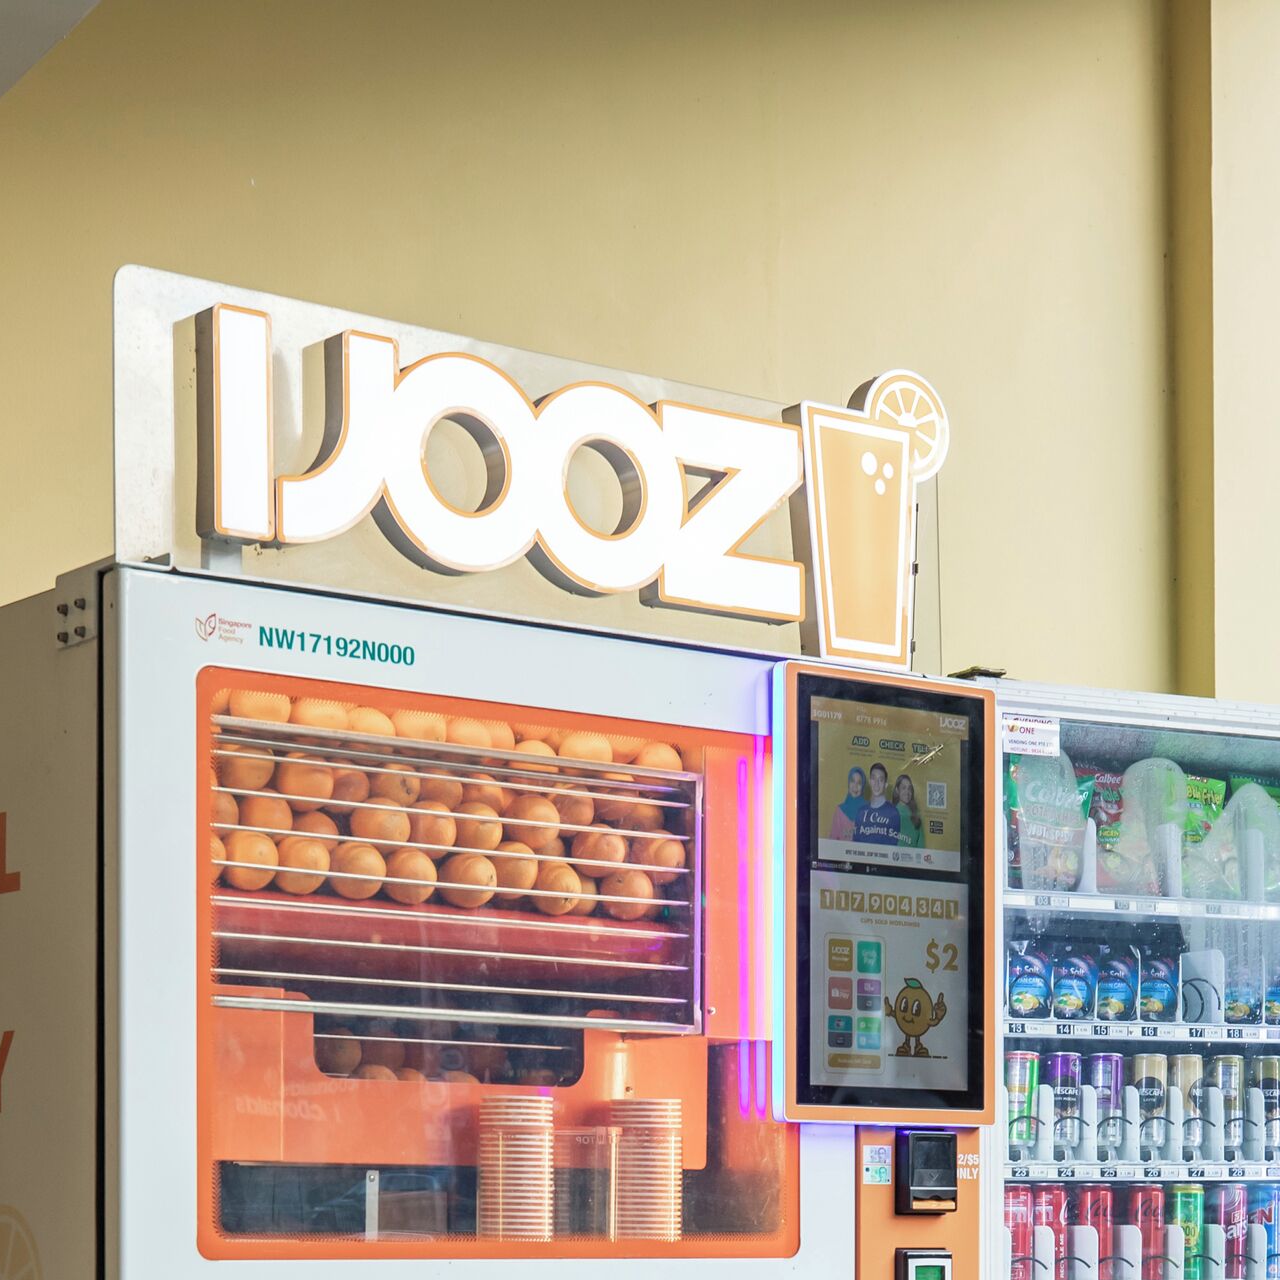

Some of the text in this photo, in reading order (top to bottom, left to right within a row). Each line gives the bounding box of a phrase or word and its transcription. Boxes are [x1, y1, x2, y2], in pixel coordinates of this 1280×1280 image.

[210, 303, 805, 623] IJOOZ
[259, 626, 415, 666] NW17192N000
[1019, 726, 1035, 735] ONE
[853, 737, 869, 746] ADD
[880, 740, 905, 750] CHECK
[1094, 773, 1122, 785] Calbee
[869, 811, 890, 824] Can
[859, 825, 887, 837] Against
[889, 828, 912, 845] Scams
[926, 937, 959, 974] $2
[1011, 1024, 1022, 1033] 13
[1058, 1025, 1070, 1034] 14
[1095, 1026, 1107, 1035] 15
[1143, 1027, 1154, 1036] 16
[1191, 1029, 1202, 1037] 17
[1229, 1029, 1240, 1038] 18
[957, 1154, 979, 1166] 2/$5
[957, 1167, 979, 1180] NLY
[1060, 1169, 1072, 1177] 24
[1192, 1169, 1203, 1178] 27
[1232, 1168, 1243, 1177] 28
[1059, 1233, 1065, 1245] ME
